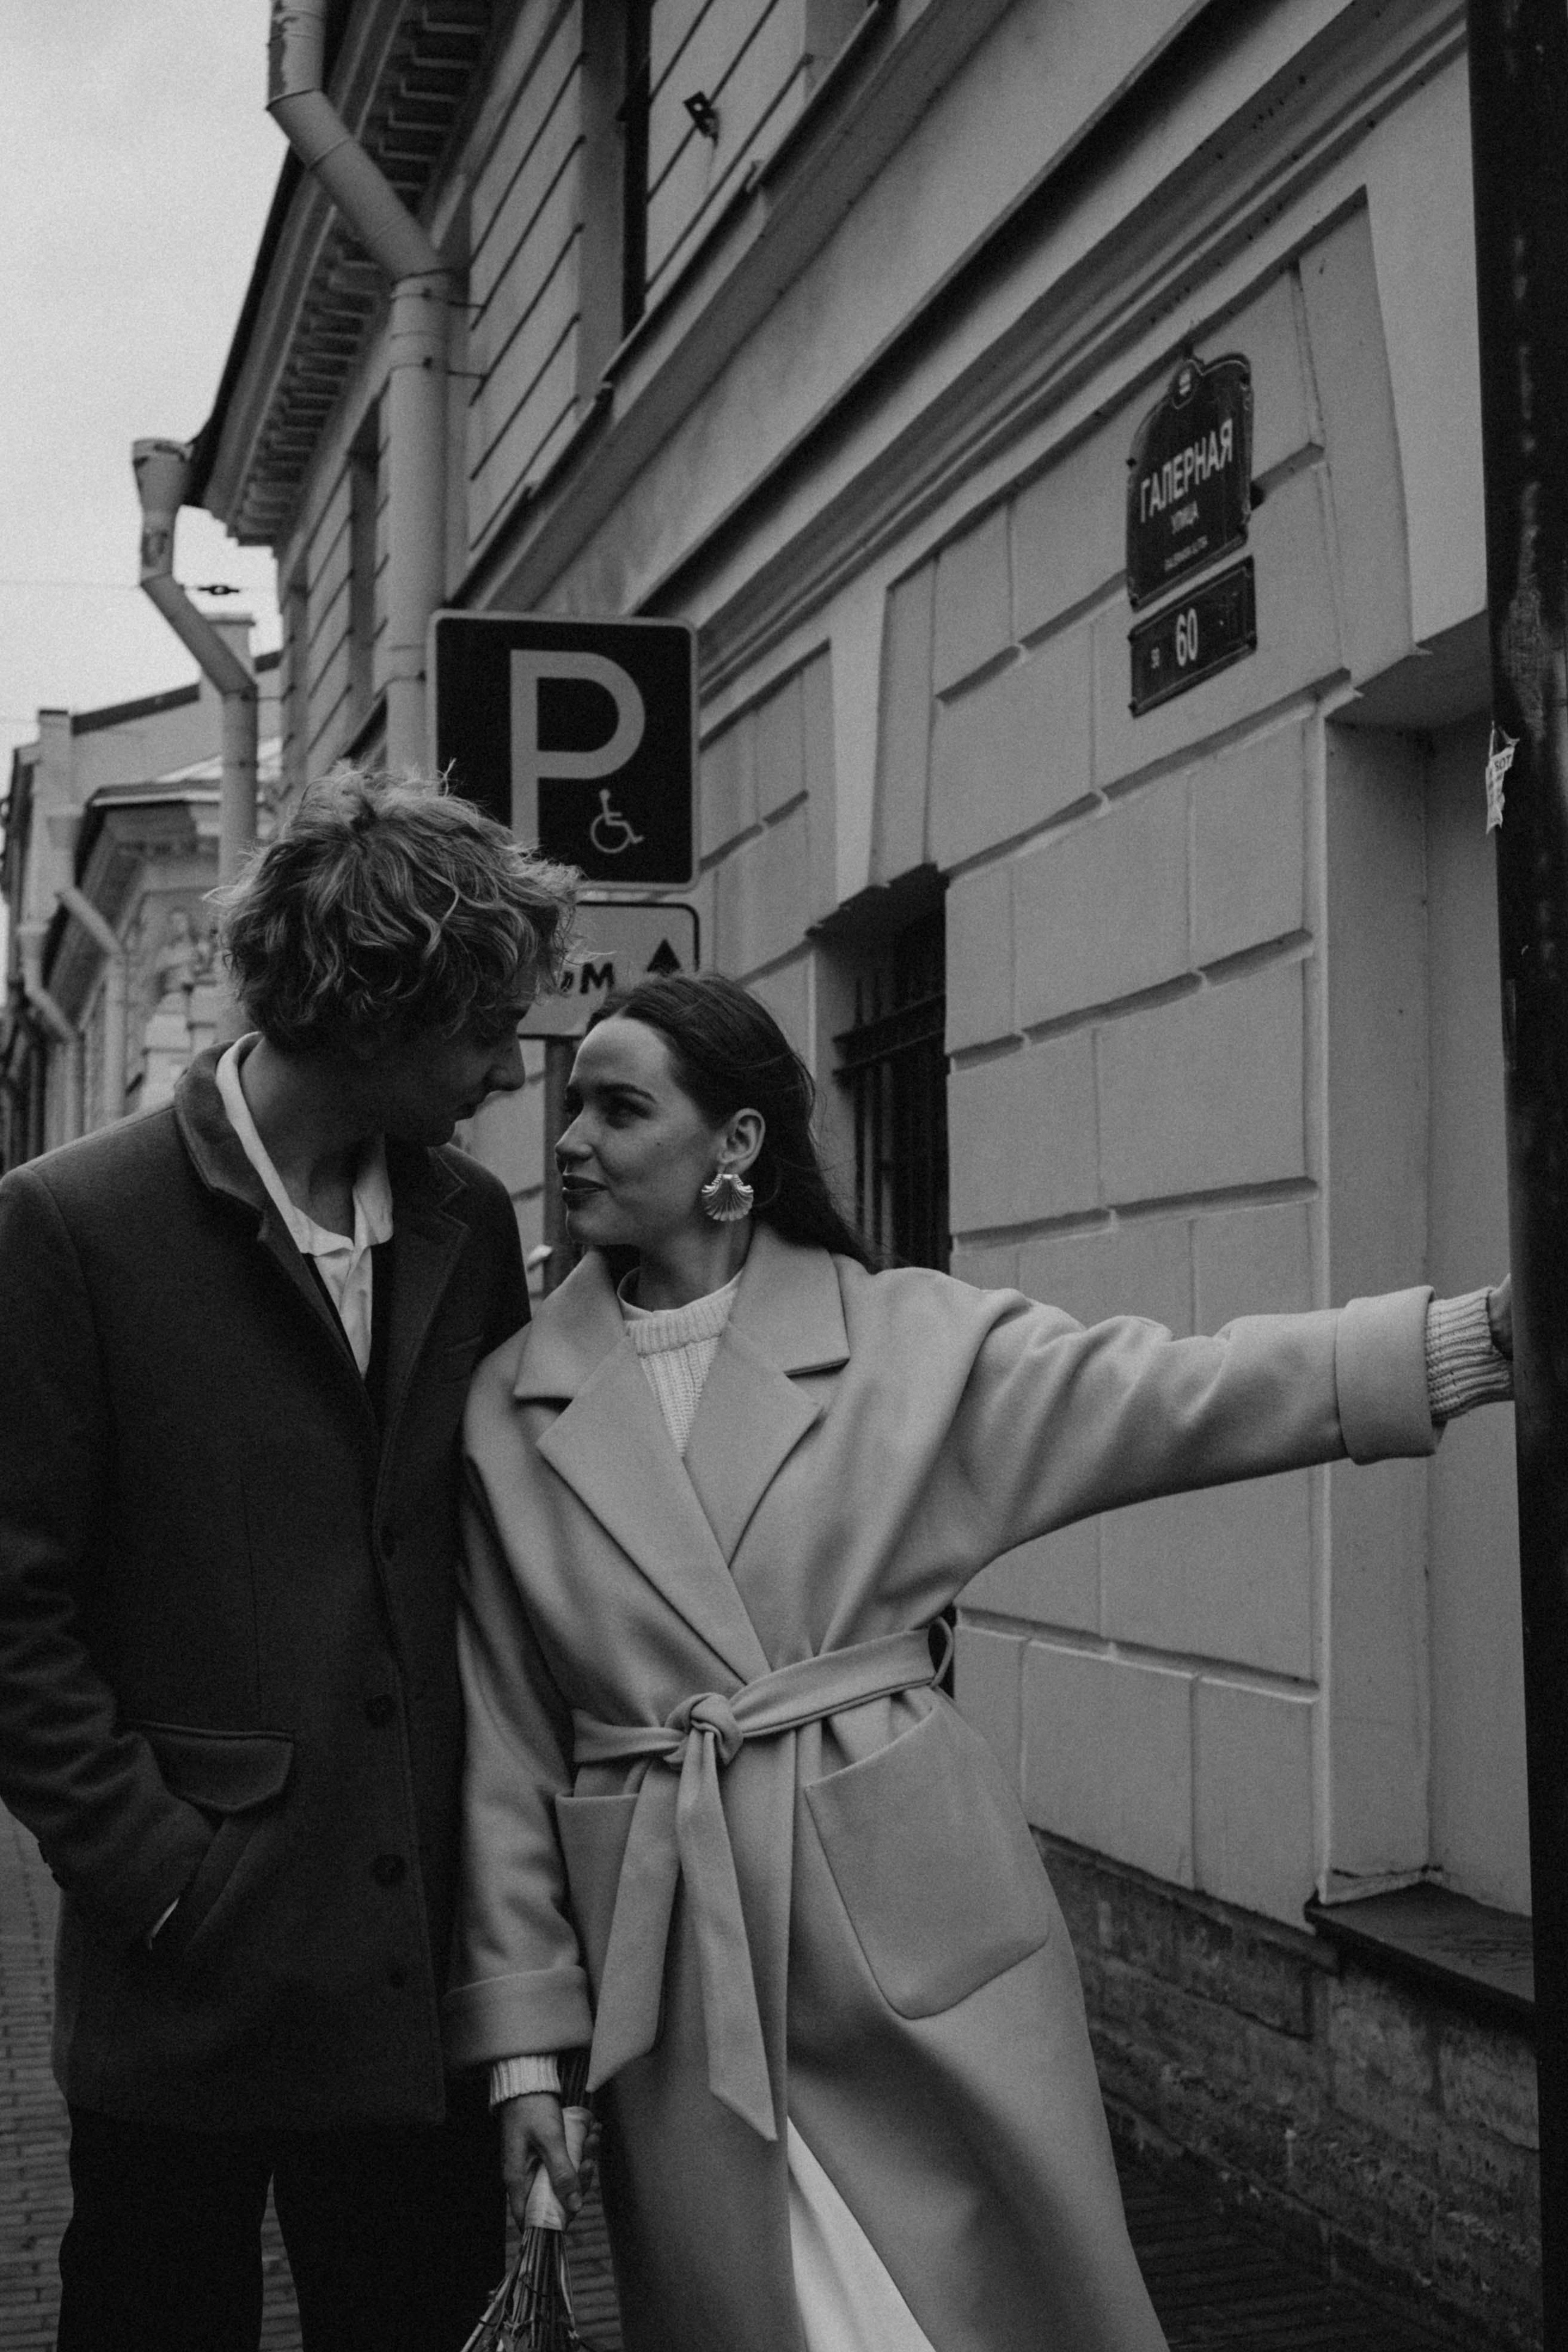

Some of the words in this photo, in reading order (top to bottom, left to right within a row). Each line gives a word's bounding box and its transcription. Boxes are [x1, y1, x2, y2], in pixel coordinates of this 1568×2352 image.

[1140, 418, 1233, 523] ГАЛЕРНАЯ
[1176, 608, 1198, 666] 60
[511, 649, 645, 853] P
